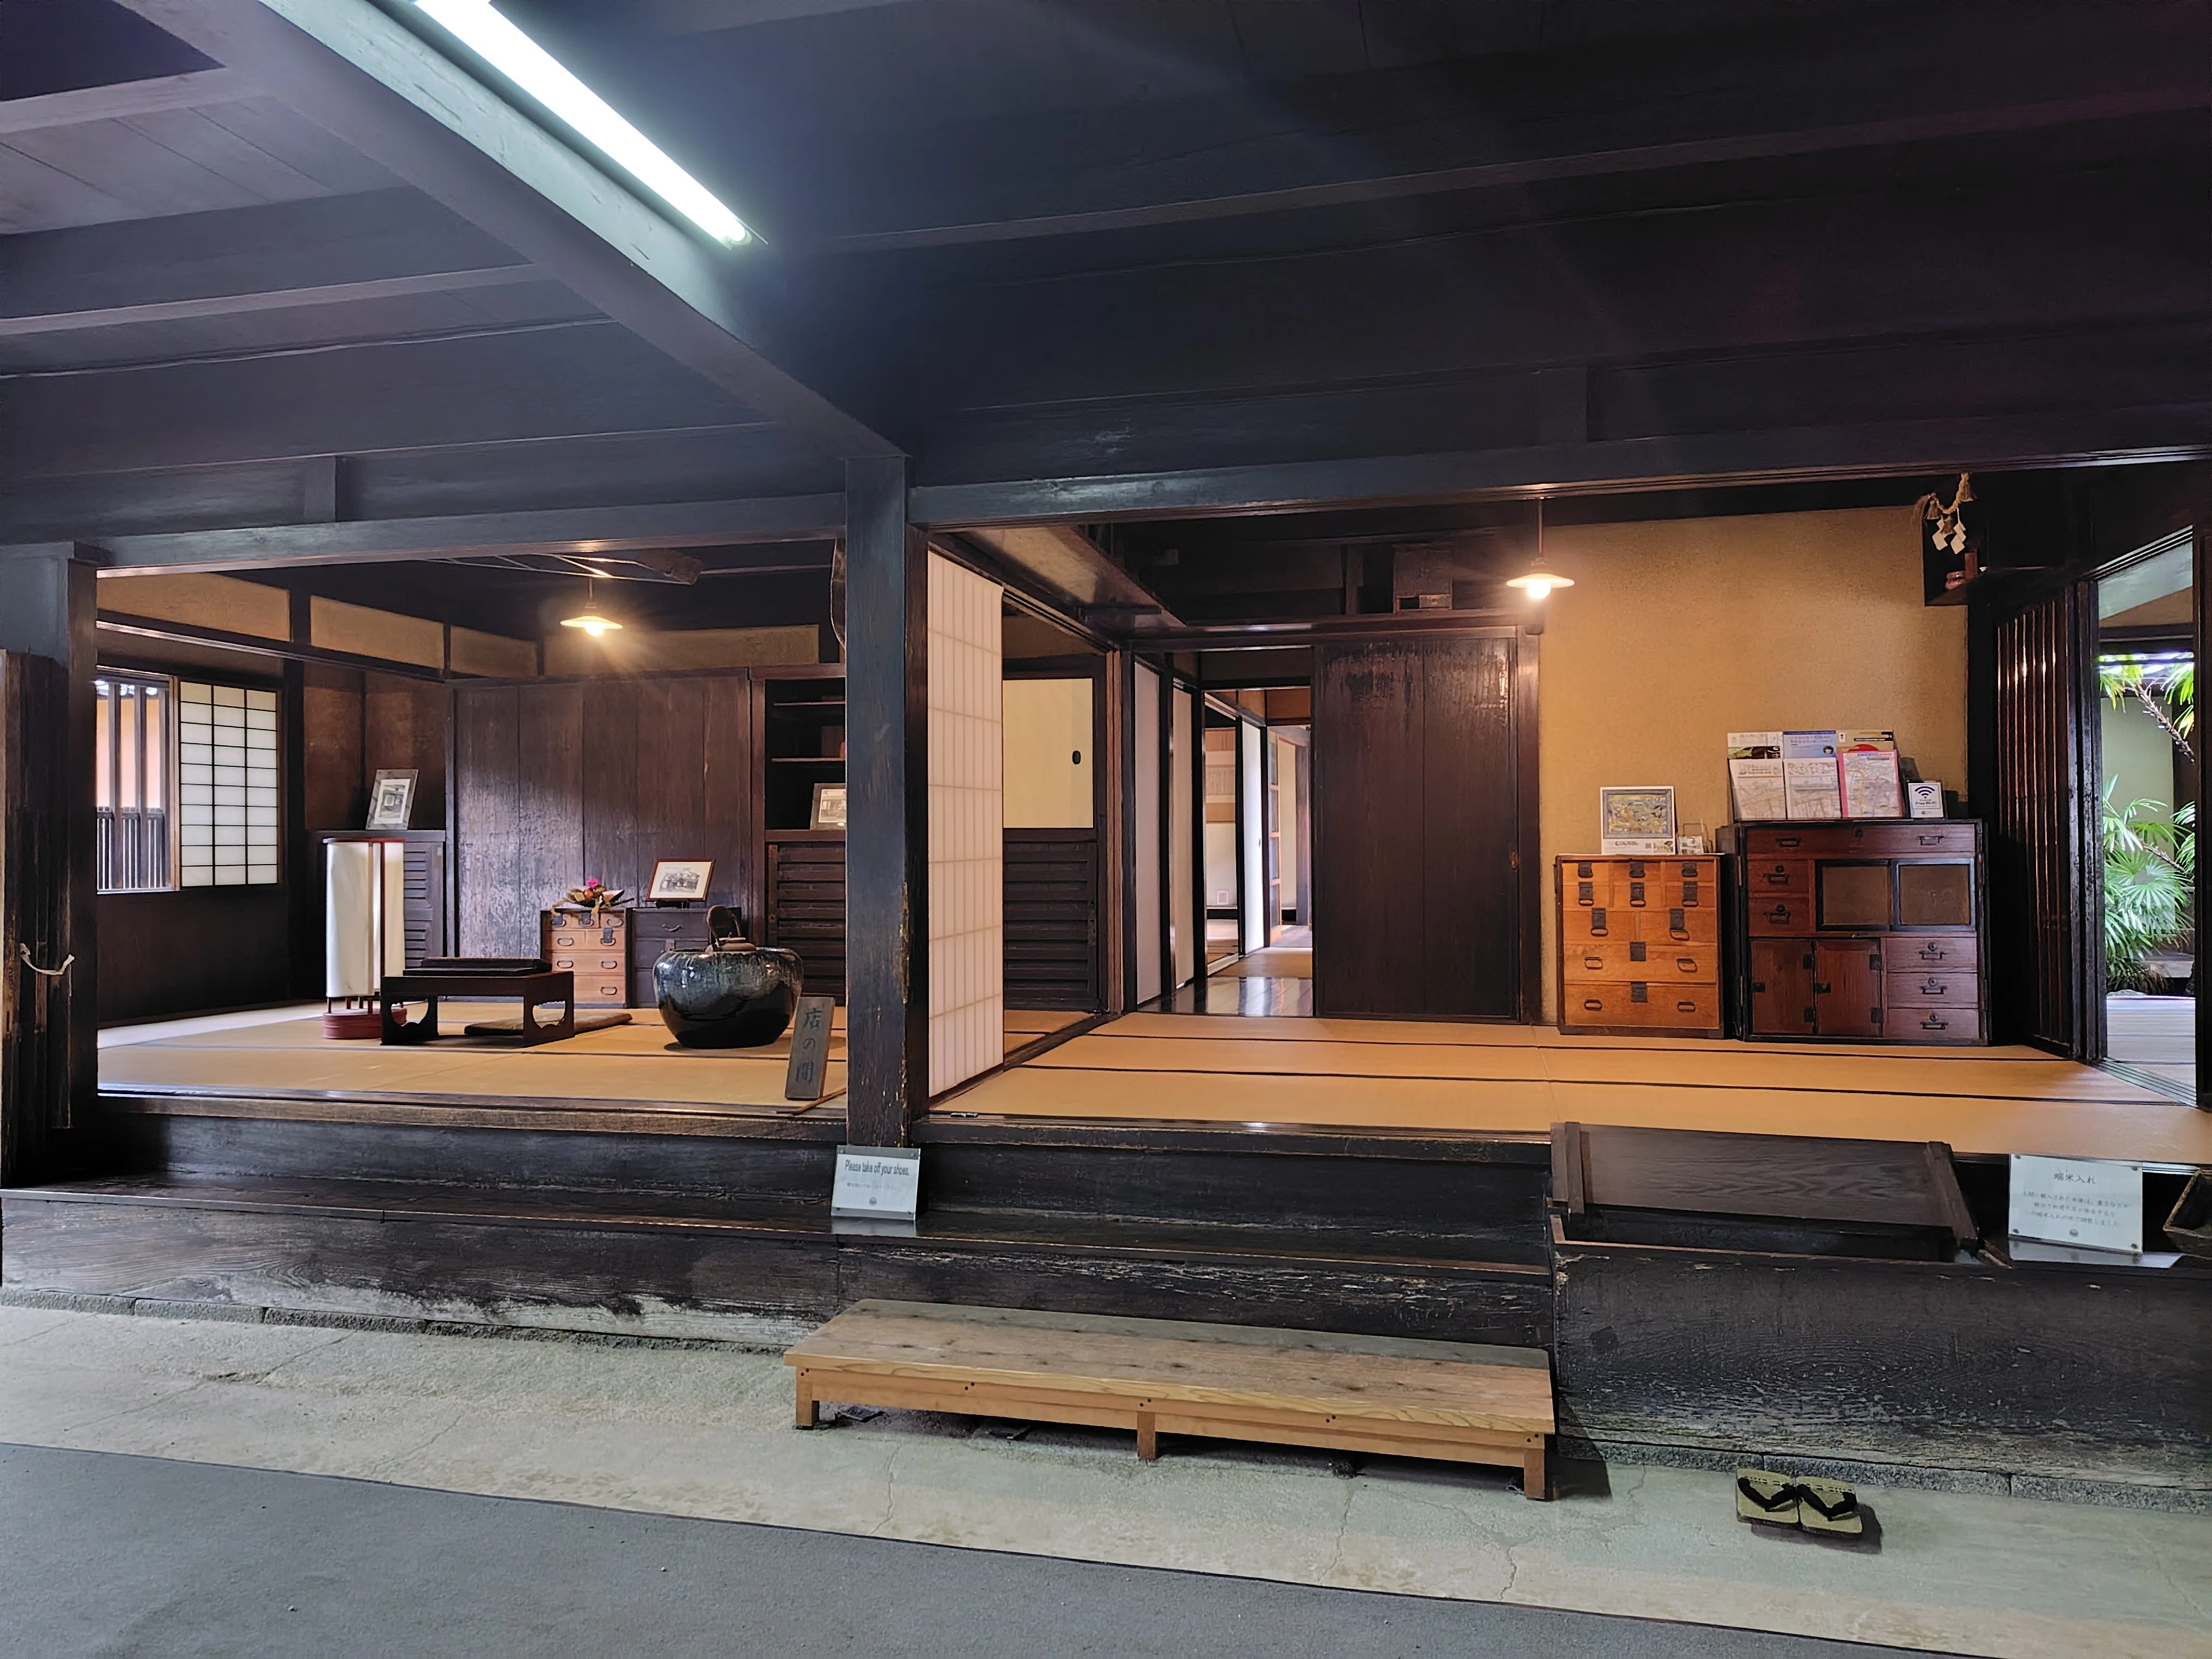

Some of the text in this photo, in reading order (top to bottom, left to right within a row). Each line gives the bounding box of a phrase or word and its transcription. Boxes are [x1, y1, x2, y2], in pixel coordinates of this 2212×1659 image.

[796, 1007, 823, 1085] 店の間
[845, 1159, 910, 1176] Please take off your shoes.
[2053, 1172, 2096, 1184] 端米入れ
